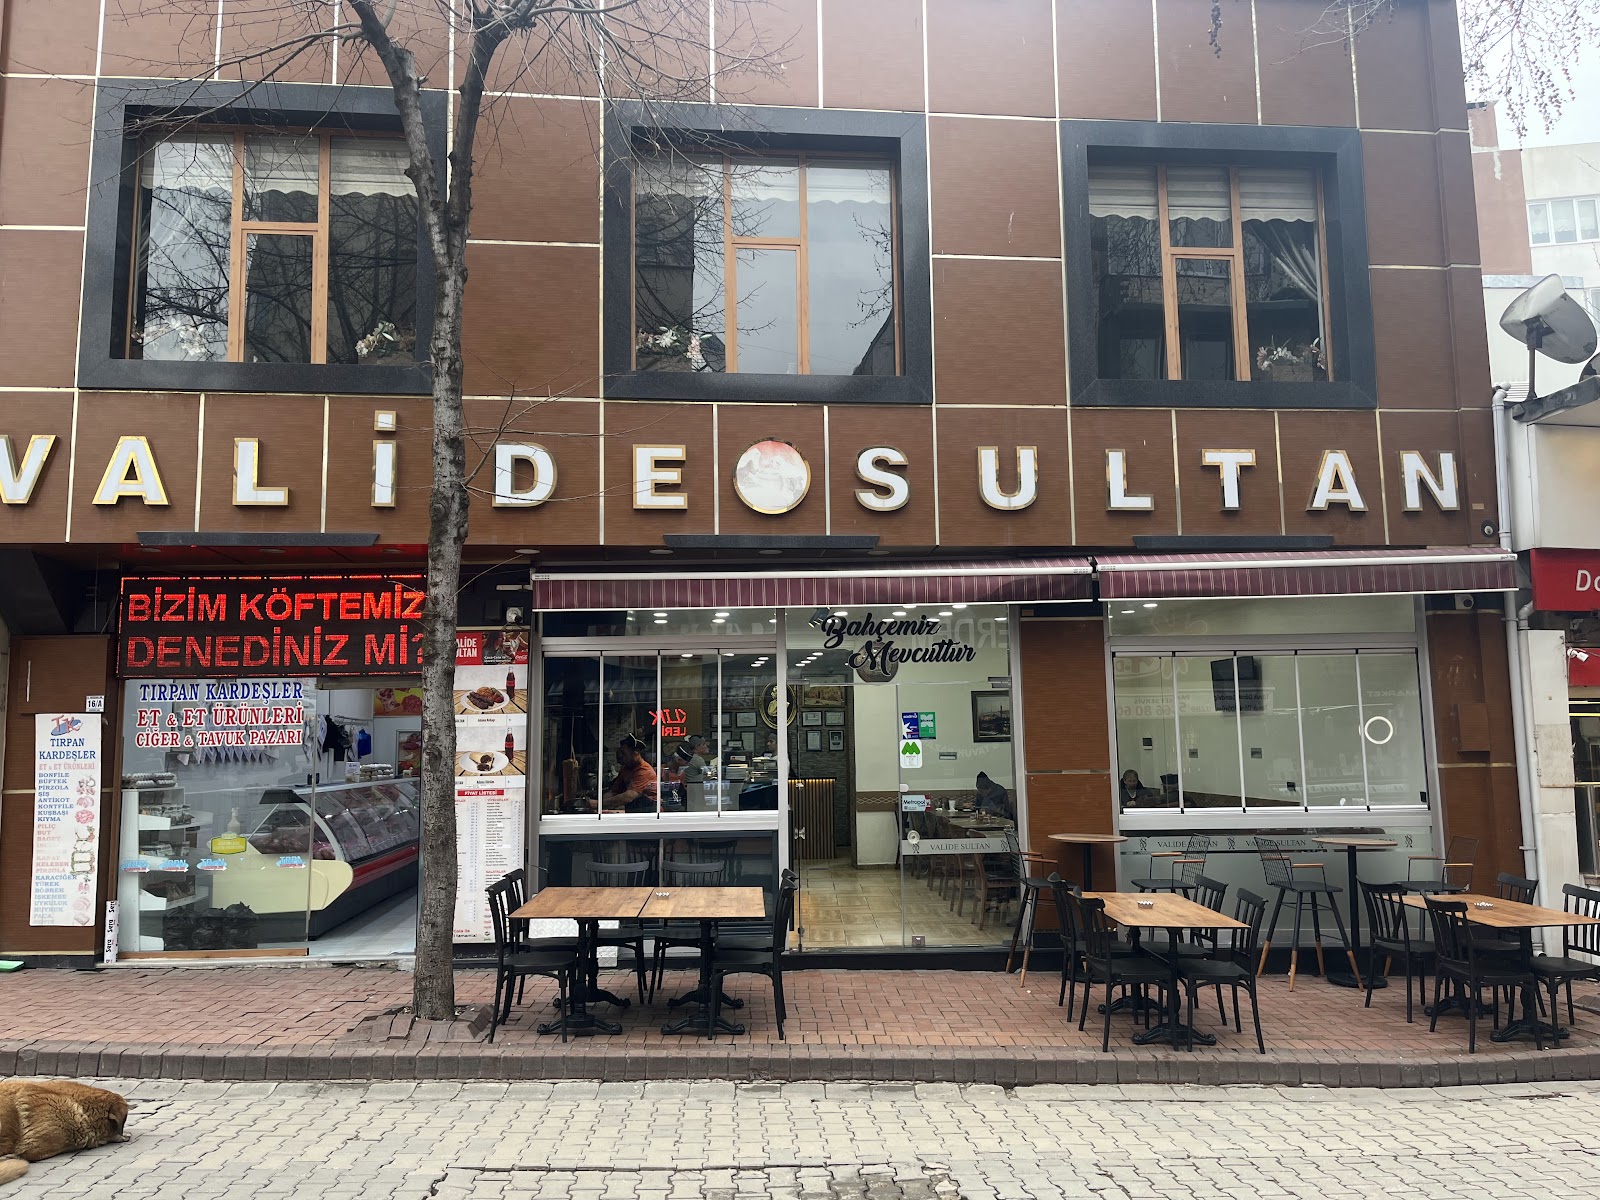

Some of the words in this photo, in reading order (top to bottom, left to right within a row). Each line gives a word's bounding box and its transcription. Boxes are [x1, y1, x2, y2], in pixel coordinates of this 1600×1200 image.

[854, 445, 1460, 513] SULTAN
[128, 586, 226, 621] BİZİM
[821, 612, 942, 648] Bahçemiz
[126, 626, 349, 667] DENEDİNİZ
[849, 639, 977, 676] Mevcuttur
[88, 699, 103, 708] 16/A
[139, 683, 200, 701] TIRPAN
[205, 681, 304, 704] KARDEŞLER
[136, 708, 161, 727] ET
[166, 713, 177, 727] &
[182, 708, 207, 727] ET
[213, 702, 304, 726] ÜRÜNLERİ
[50, 738, 85, 747] TIRPAN
[136, 728, 180, 748] CİĞER
[184, 735, 193, 747] &
[198, 731, 246, 747] TAVUK
[249, 730, 303, 746] PAZARI
[39, 751, 96, 761] KARDEŞLER
[39, 763, 47, 771] ET
[63, 762, 95, 770] ÜRÜNLERİ
